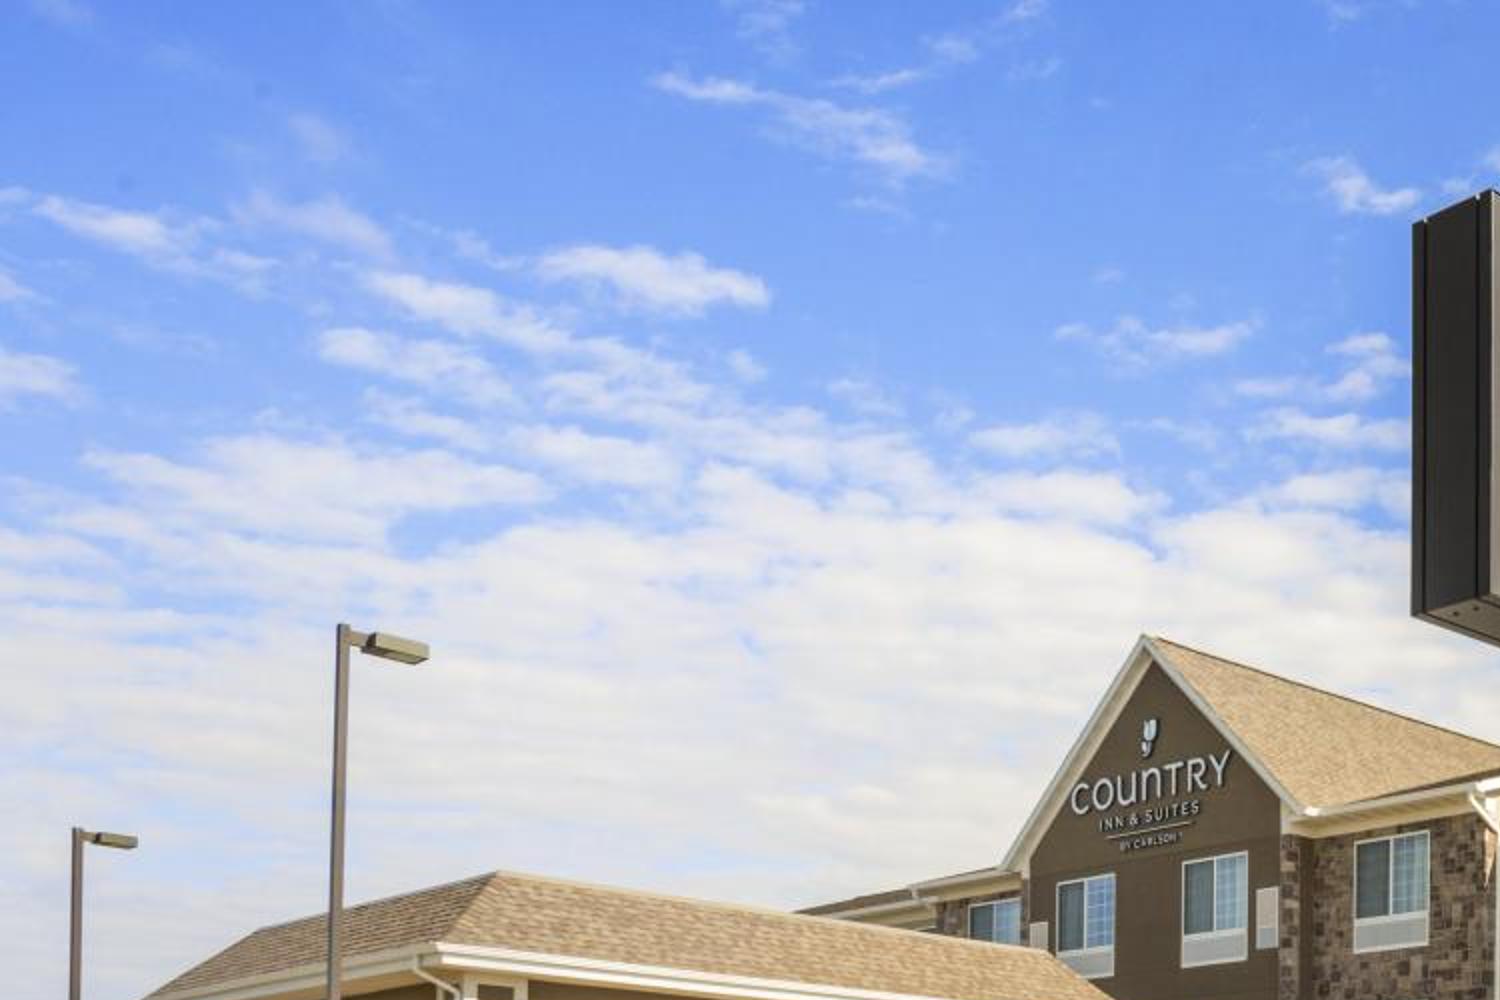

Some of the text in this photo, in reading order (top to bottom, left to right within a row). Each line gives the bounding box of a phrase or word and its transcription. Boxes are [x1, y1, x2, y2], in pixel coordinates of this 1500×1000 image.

[1099, 800, 1200, 832] INN & SUITES
